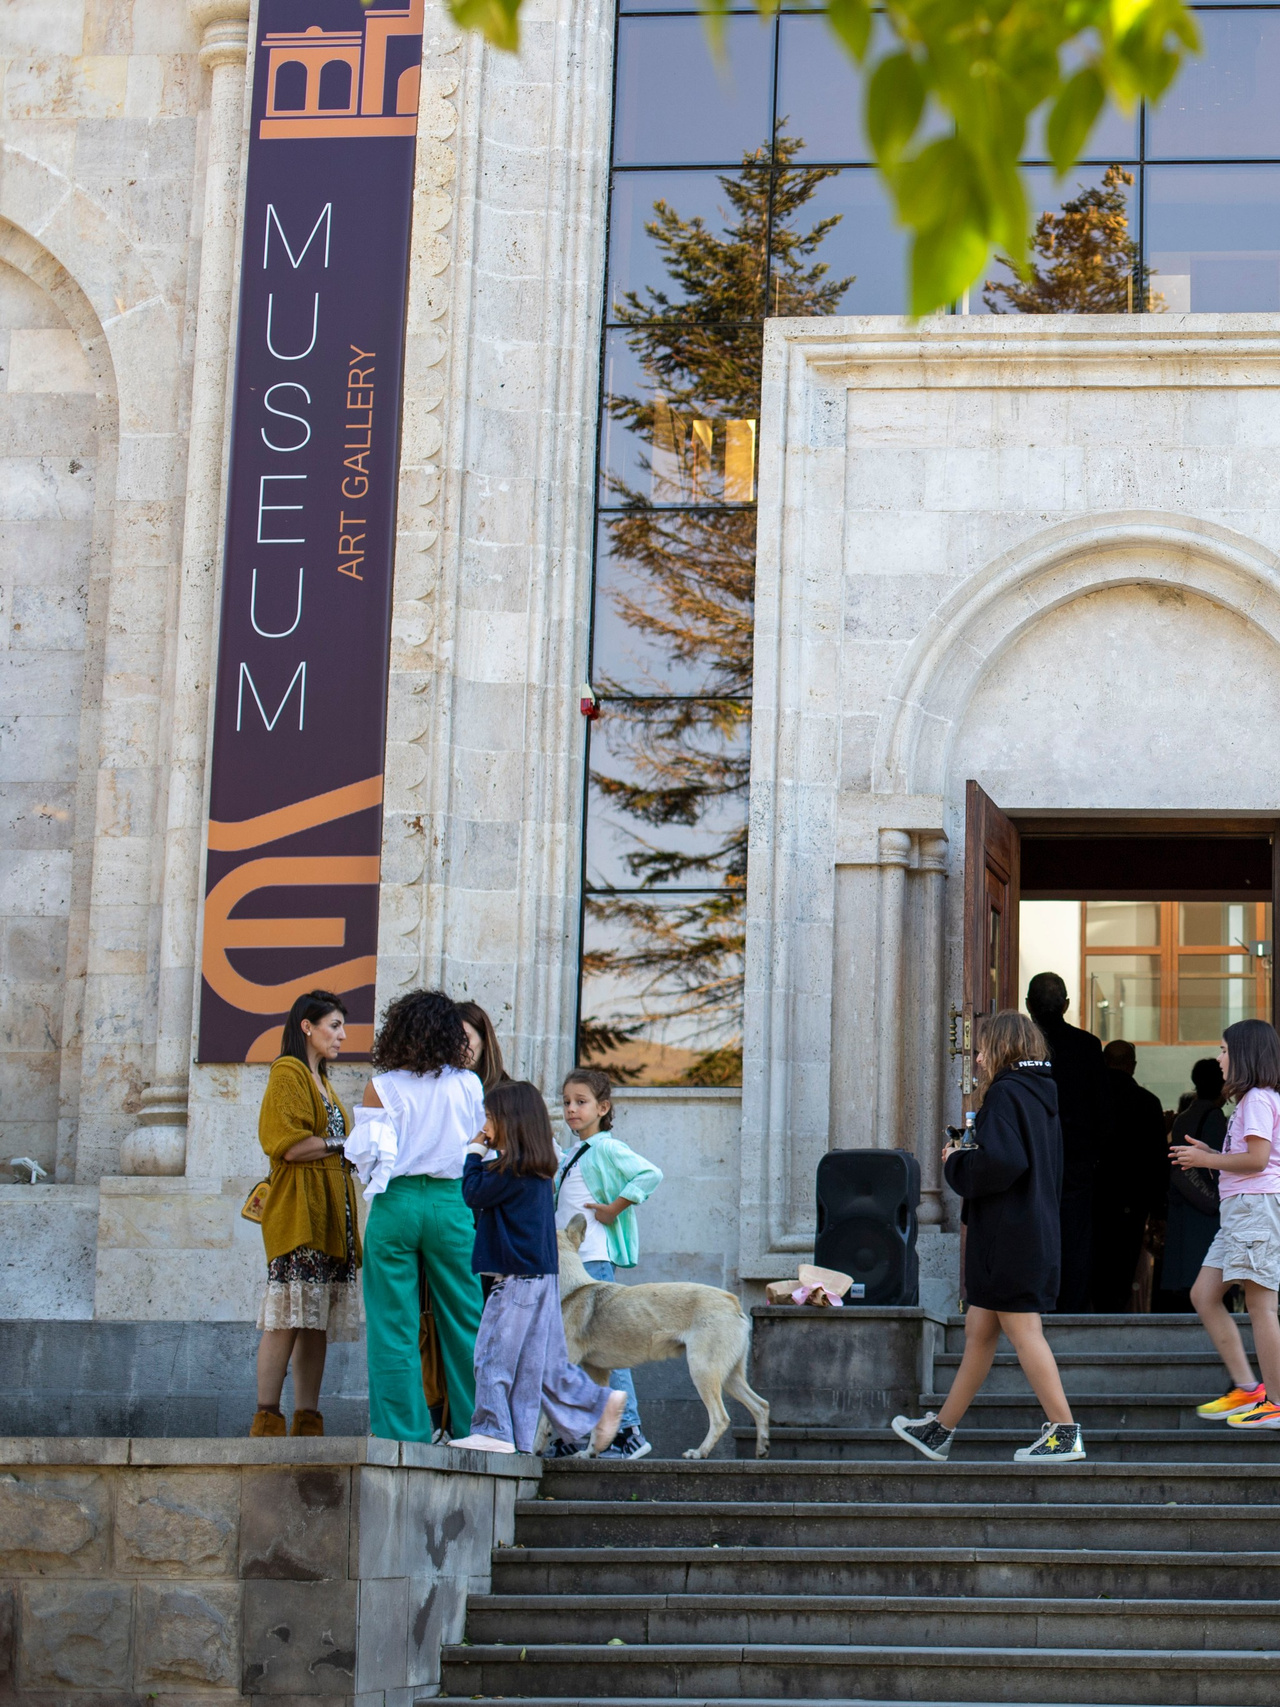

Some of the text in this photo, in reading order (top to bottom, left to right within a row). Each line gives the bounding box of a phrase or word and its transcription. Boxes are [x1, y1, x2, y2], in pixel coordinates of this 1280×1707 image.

[236, 202, 332, 732] MUSEUM
[337, 344, 376, 581] ART GALLERY
